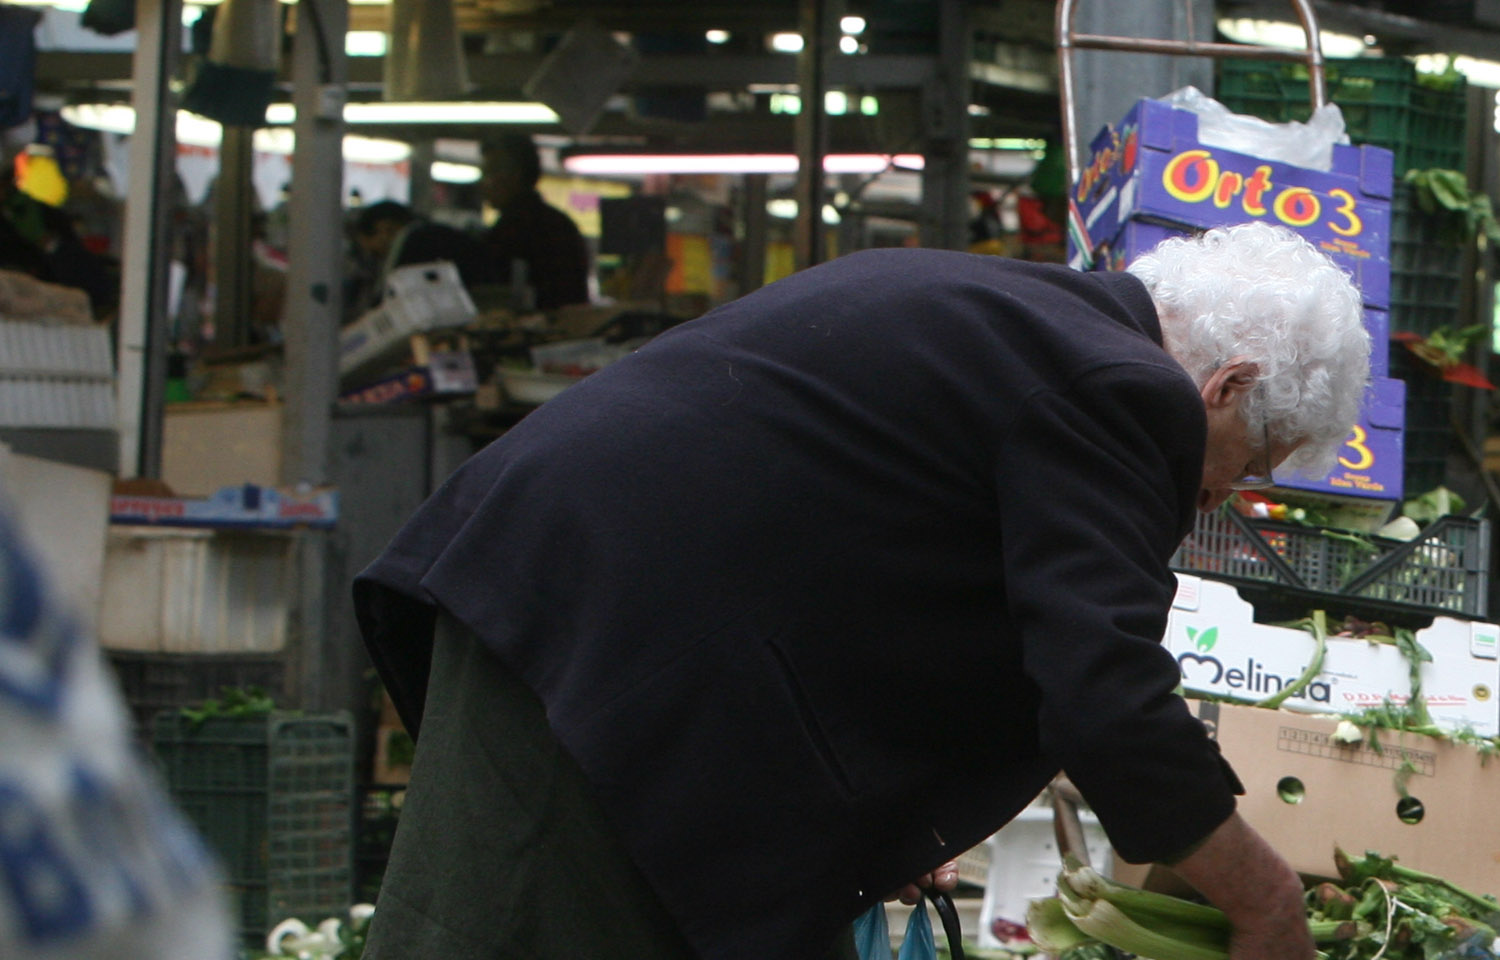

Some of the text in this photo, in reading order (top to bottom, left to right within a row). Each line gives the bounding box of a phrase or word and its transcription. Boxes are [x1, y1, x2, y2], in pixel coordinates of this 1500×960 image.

[1163, 150, 1363, 237] Orto 3
[1338, 424, 1375, 470] 3
